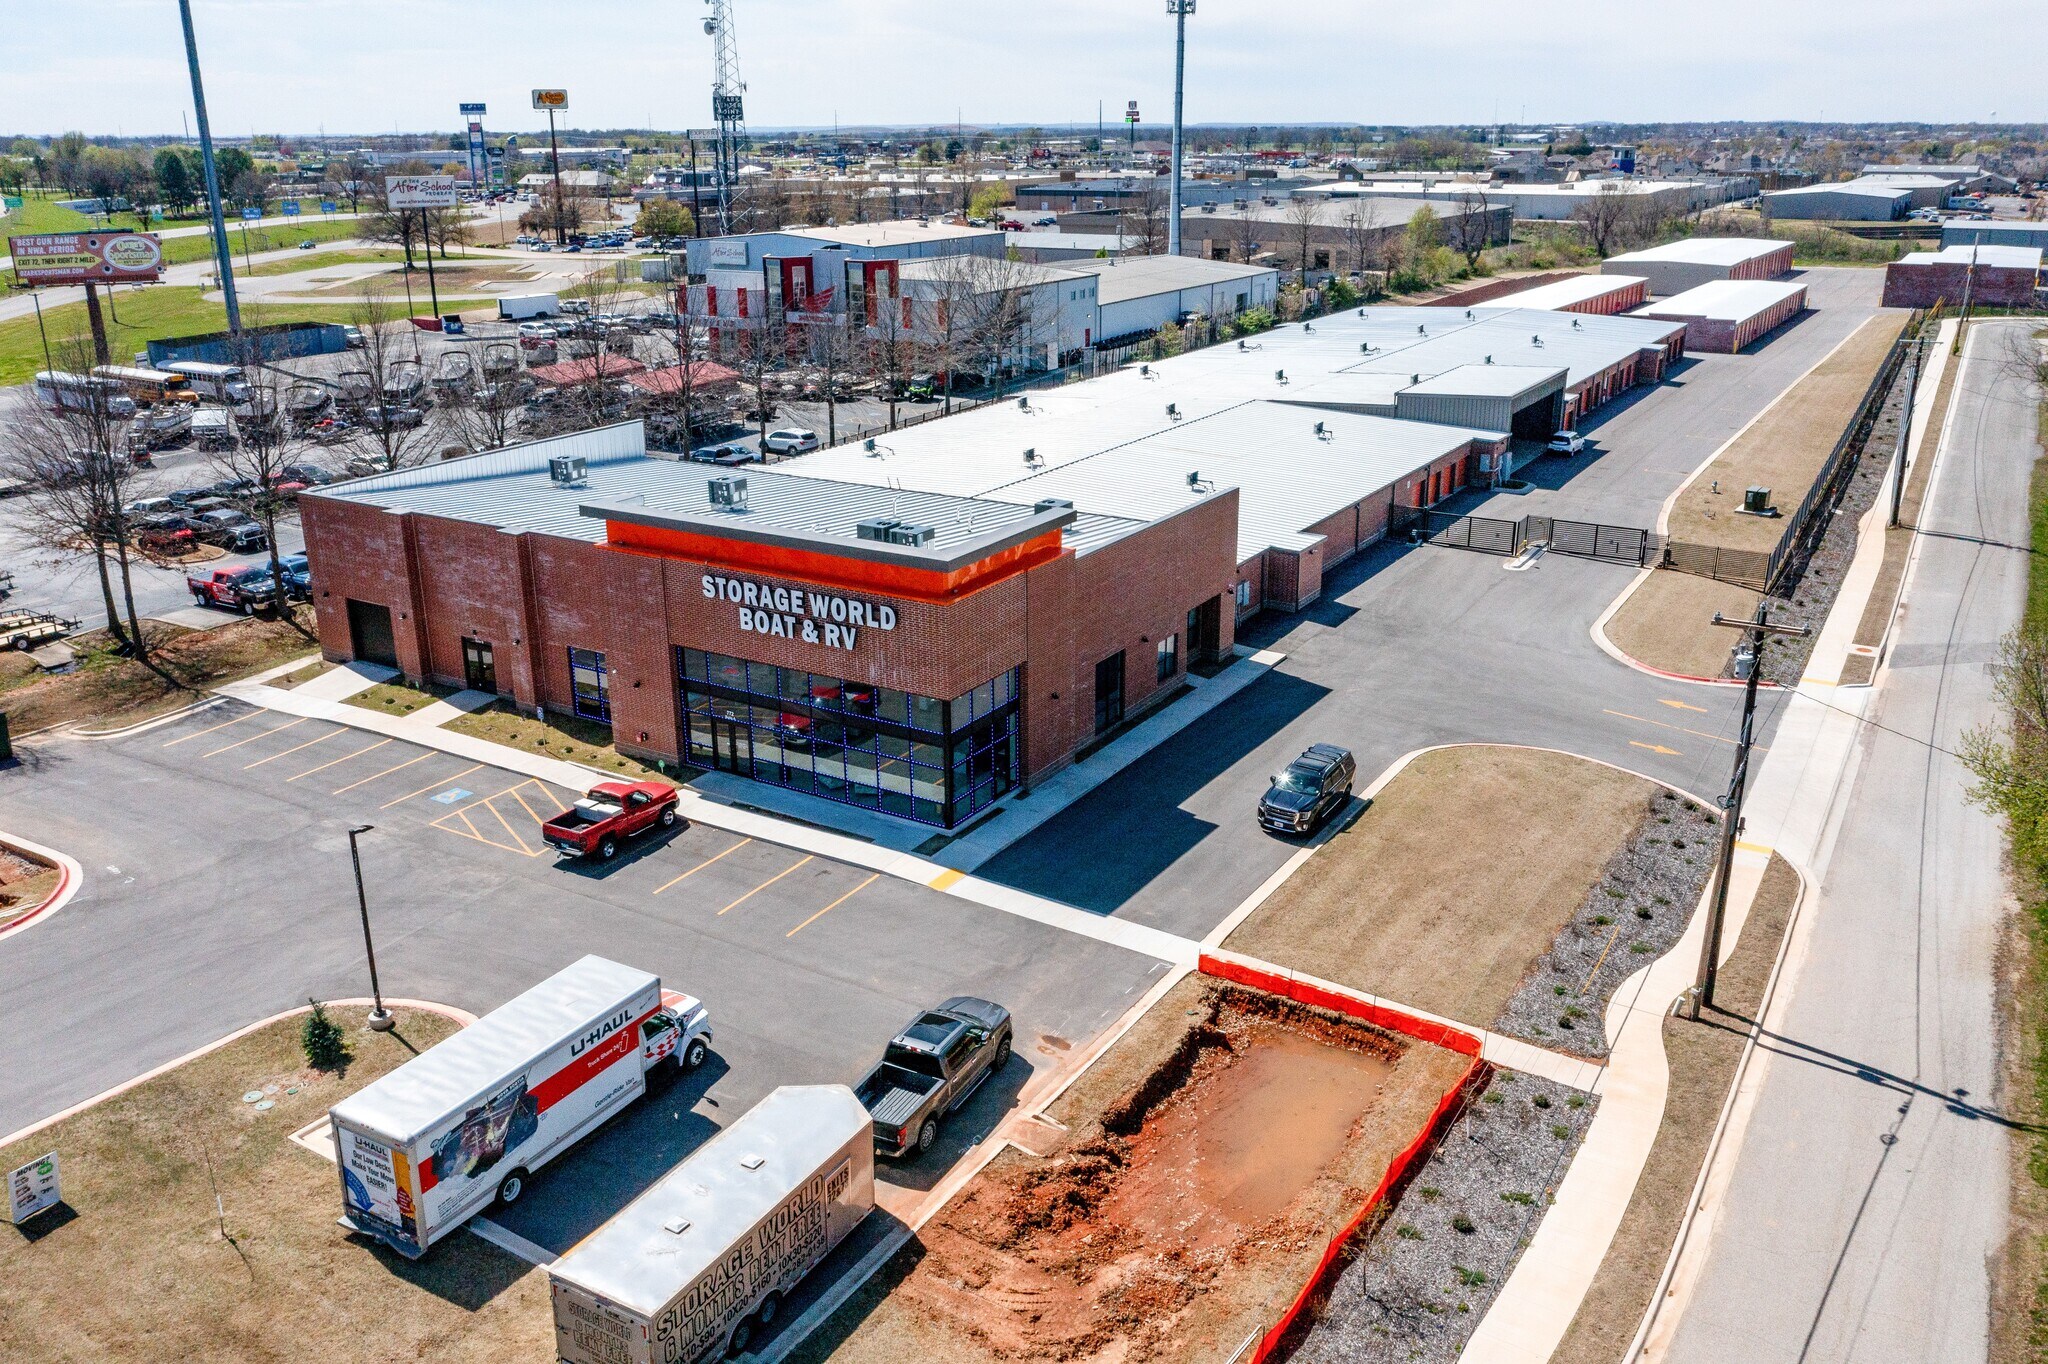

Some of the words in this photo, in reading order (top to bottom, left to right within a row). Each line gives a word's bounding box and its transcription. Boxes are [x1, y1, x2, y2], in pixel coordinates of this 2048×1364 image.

[389, 180, 419, 194] After
[420, 181, 454, 192] School
[37, 238, 53, 246] GUN
[54, 236, 79, 244] RANGE
[702, 575, 805, 615] STORAGE
[809, 592, 896, 631] WORLD
[739, 607, 796, 639] BOAT
[801, 619, 819, 645] &
[824, 622, 857, 651] RV
[827, 1167, 849, 1194] EXITS
[656, 1236, 753, 1342] STORAGE
[759, 1174, 824, 1249] WORLD
[664, 1336, 677, 1363] 6
[680, 1272, 745, 1350] MONTHS
[750, 1233, 786, 1285] RENT
[789, 1199, 822, 1248] FREE
[568, 1300, 603, 1329] STORAGE
